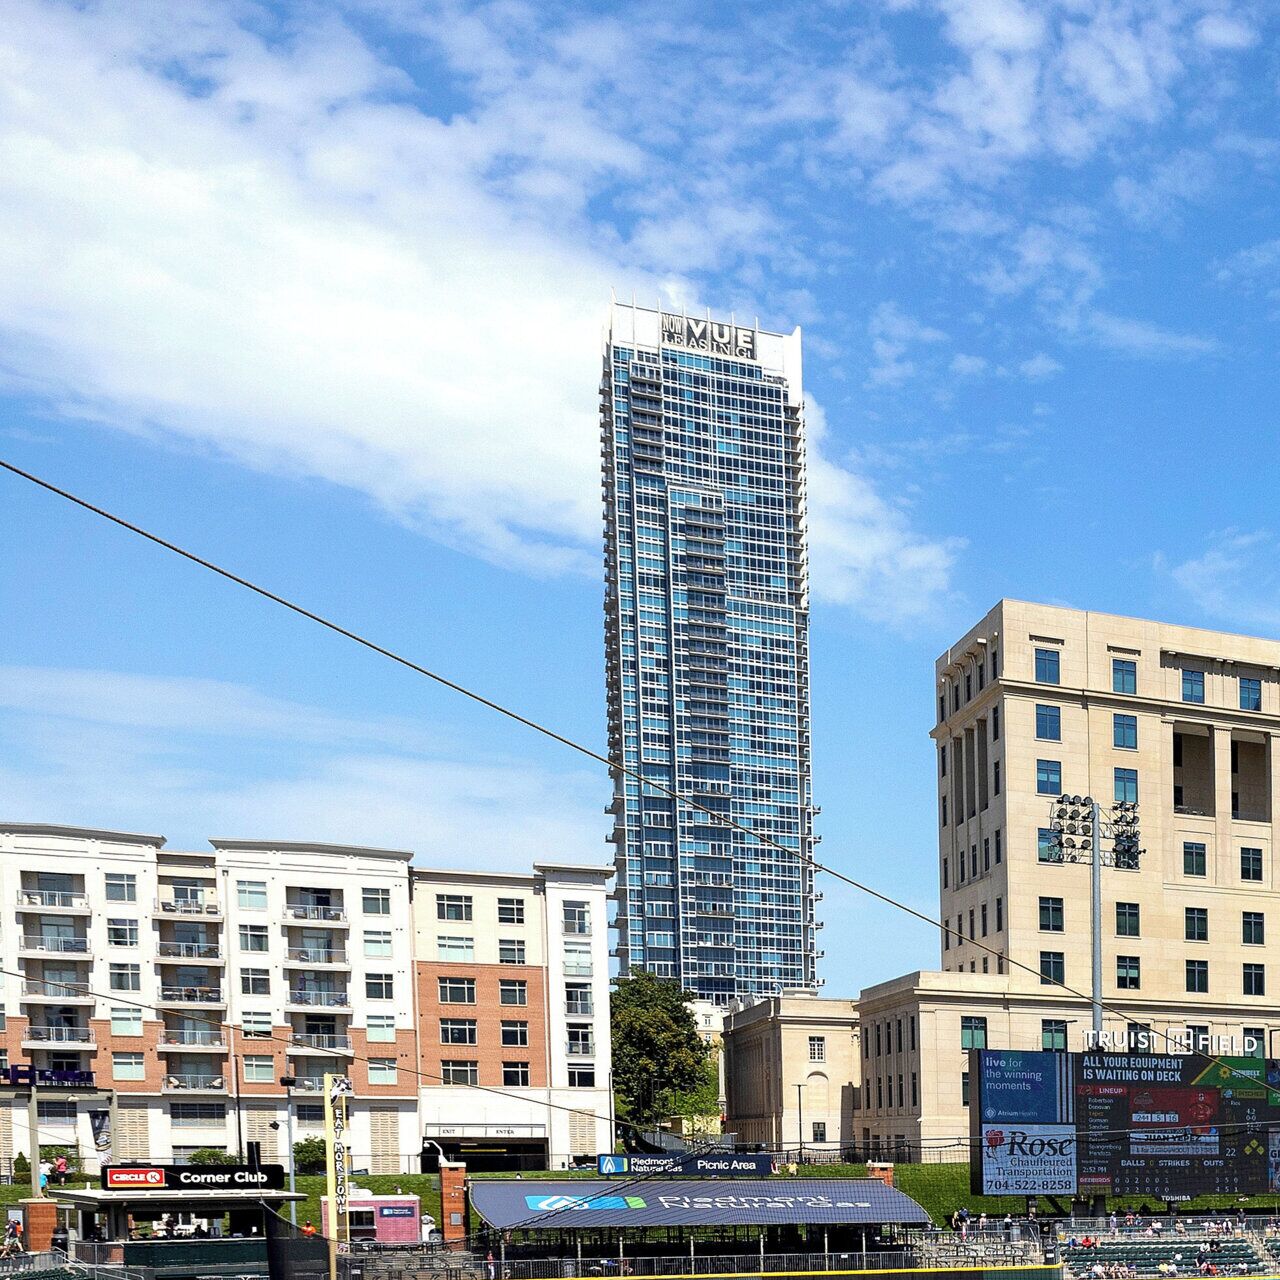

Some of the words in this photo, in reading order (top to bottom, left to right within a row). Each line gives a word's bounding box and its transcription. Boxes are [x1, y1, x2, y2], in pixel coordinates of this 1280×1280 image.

[662, 314, 682, 334] NOW
[687, 318, 754, 349] VUE
[1083, 1030, 1159, 1049] TRUIST
[1199, 1034, 1258, 1052] FIELD
[986, 1057, 1006, 1067] live
[1009, 1057, 1022, 1067] for
[1083, 1057, 1101, 1067] ALL
[1103, 1057, 1128, 1068] YOUR
[1130, 1058, 1183, 1069] EQUIPMENT
[986, 1069, 1001, 1078] the
[1004, 1070, 1042, 1081] winning
[1083, 1069, 1093, 1080] IS
[1095, 1070, 1139, 1081] WAITING
[1141, 1070, 1152, 1081] ON
[1156, 1071, 1181, 1082] DECK
[986, 1082, 1032, 1091] moments
[334, 1109, 344, 1139] EAT
[1006, 1131, 1075, 1156] Rose
[334, 1143, 344, 1172] MOR
[1225, 1148, 1236, 1157] 22
[631, 1157, 675, 1166] Piedmont
[697, 1160, 730, 1170] Picnic
[730, 1160, 756, 1170] Area
[1010, 1157, 1073, 1167] Chauffeured
[665, 1165, 683, 1173] Gas
[996, 1167, 1073, 1178] Transportation
[112, 1173, 146, 1181] CIRCLE
[180, 1172, 231, 1183] Corner
[234, 1172, 268, 1183] Club
[986, 1180, 1072, 1190] 704-522-8258
[335, 1176, 347, 1214] FOWL
[658, 1195, 832, 1203] Piedmont
